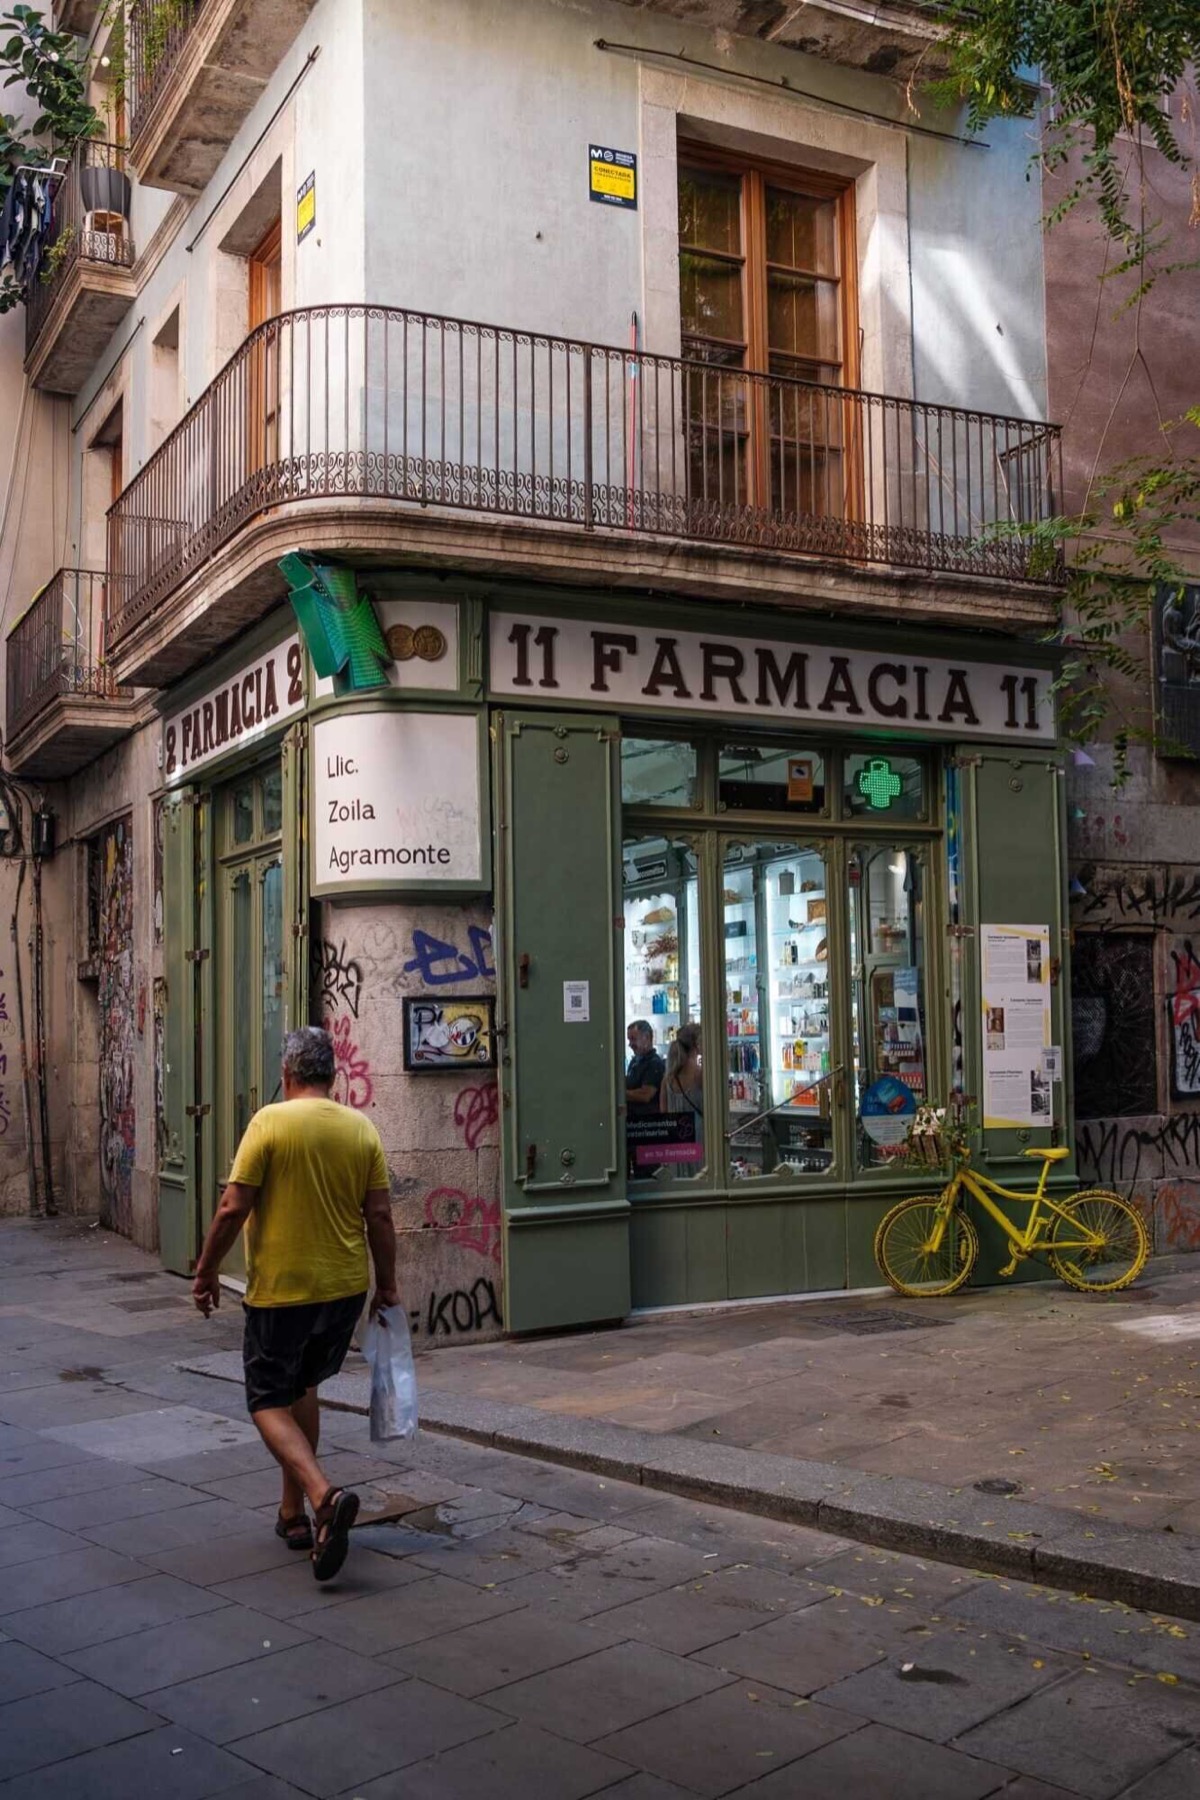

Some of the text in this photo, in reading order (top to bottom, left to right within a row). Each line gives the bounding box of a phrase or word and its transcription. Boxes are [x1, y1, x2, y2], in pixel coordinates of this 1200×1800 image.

[508, 623, 1040, 730] 11 FARMACIA 11
[181, 659, 279, 767] FARMACIA
[327, 754, 359, 778] Llic.
[328, 799, 376, 824] Zoila
[329, 844, 451, 874] Agramonte
